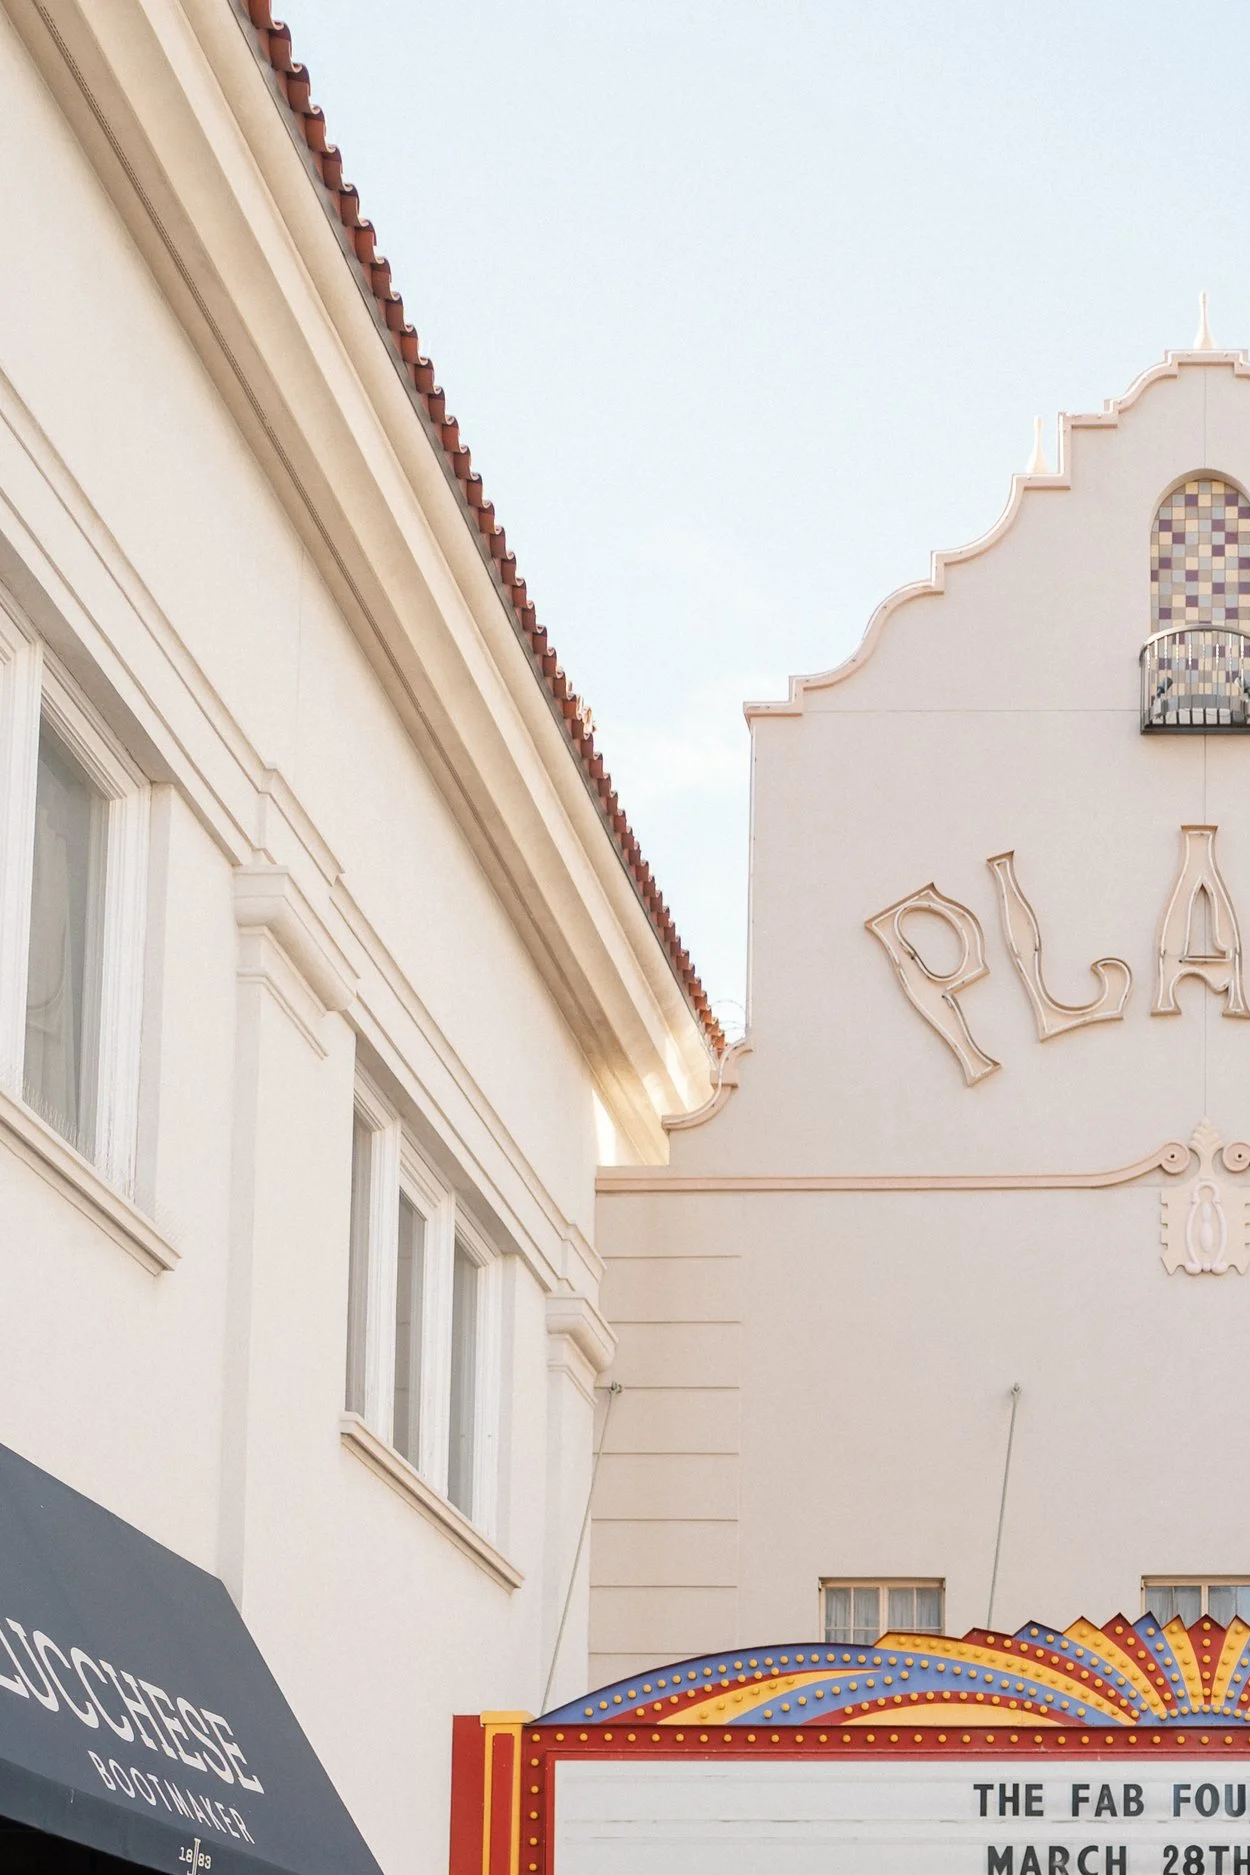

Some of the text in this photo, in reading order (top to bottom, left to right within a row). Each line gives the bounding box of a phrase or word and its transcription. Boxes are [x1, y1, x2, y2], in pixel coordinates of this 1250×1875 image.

[0, 1617, 265, 1794] LUCCHESE
[88, 1750, 255, 1844] BOOTMAKER
[973, 1783, 1045, 1817] THE
[1072, 1783, 1145, 1817] FAB
